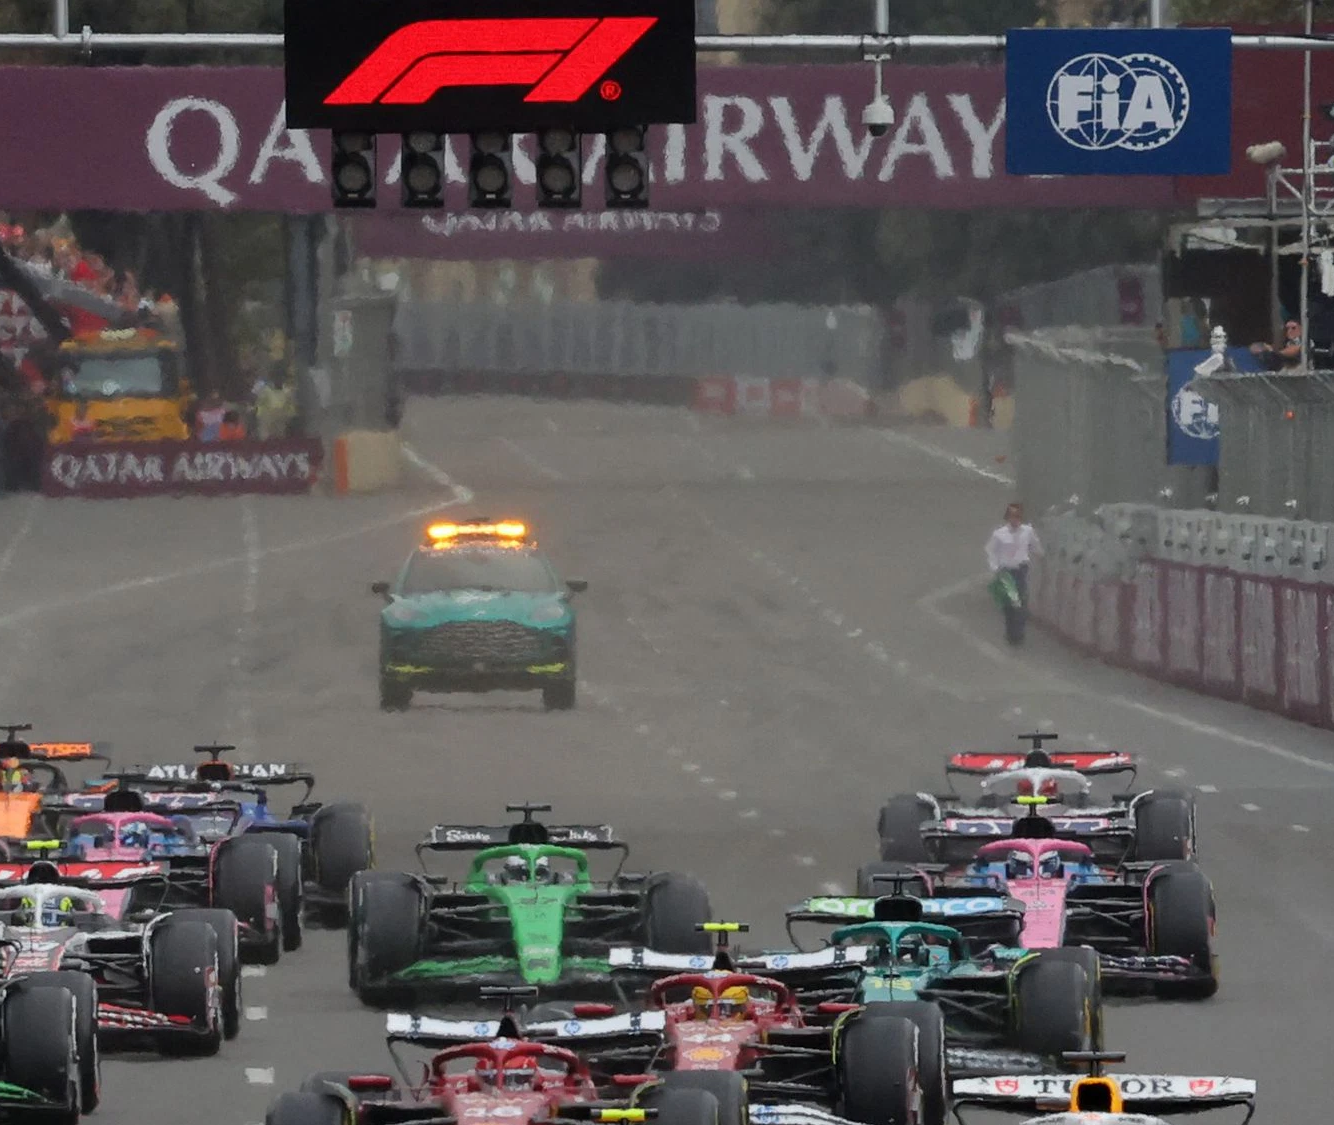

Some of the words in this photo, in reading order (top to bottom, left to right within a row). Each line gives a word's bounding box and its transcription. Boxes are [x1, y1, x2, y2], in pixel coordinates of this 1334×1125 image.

[52, 450, 161, 487] QATAR
[172, 452, 310, 482] AIRWAYS
[1033, 1078, 1175, 1094] TUOR
